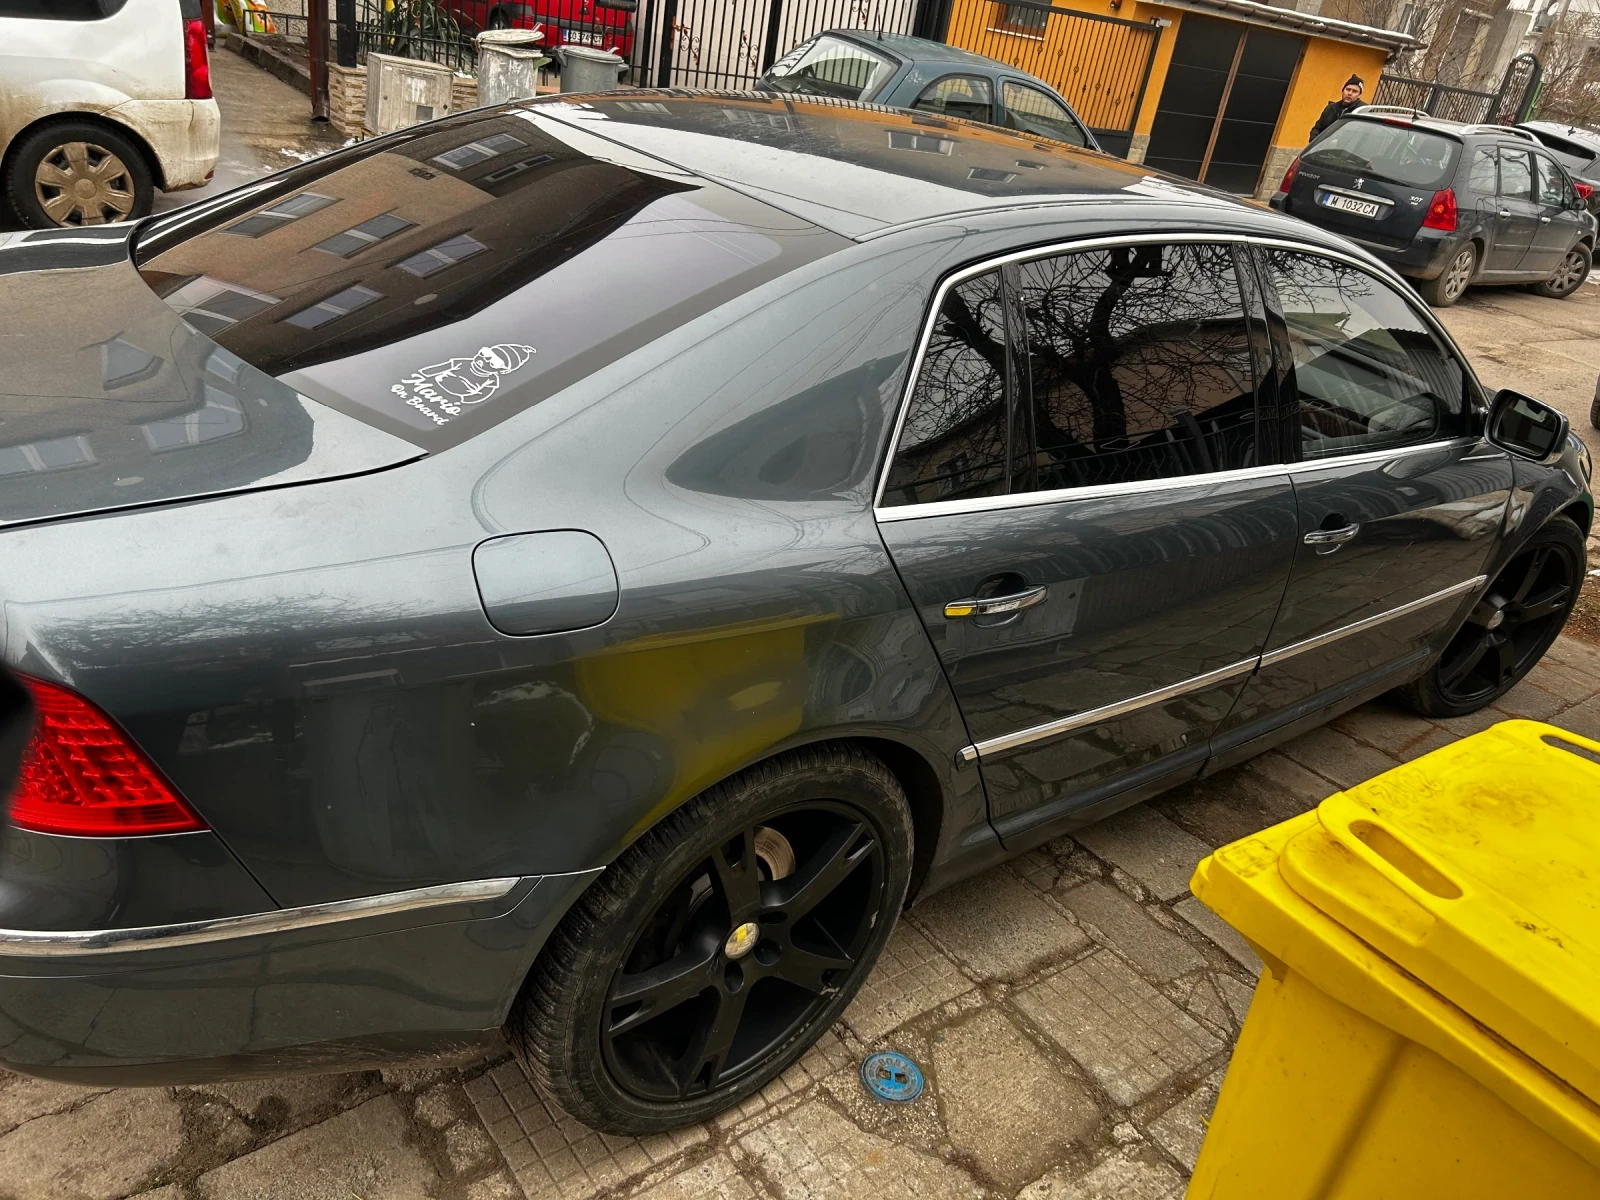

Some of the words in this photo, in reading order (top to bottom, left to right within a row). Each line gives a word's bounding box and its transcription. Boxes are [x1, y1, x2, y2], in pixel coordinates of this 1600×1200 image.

[391, 384, 408, 399] On
[405, 395, 449, 426] Board
[401, 373, 462, 416] Mario
